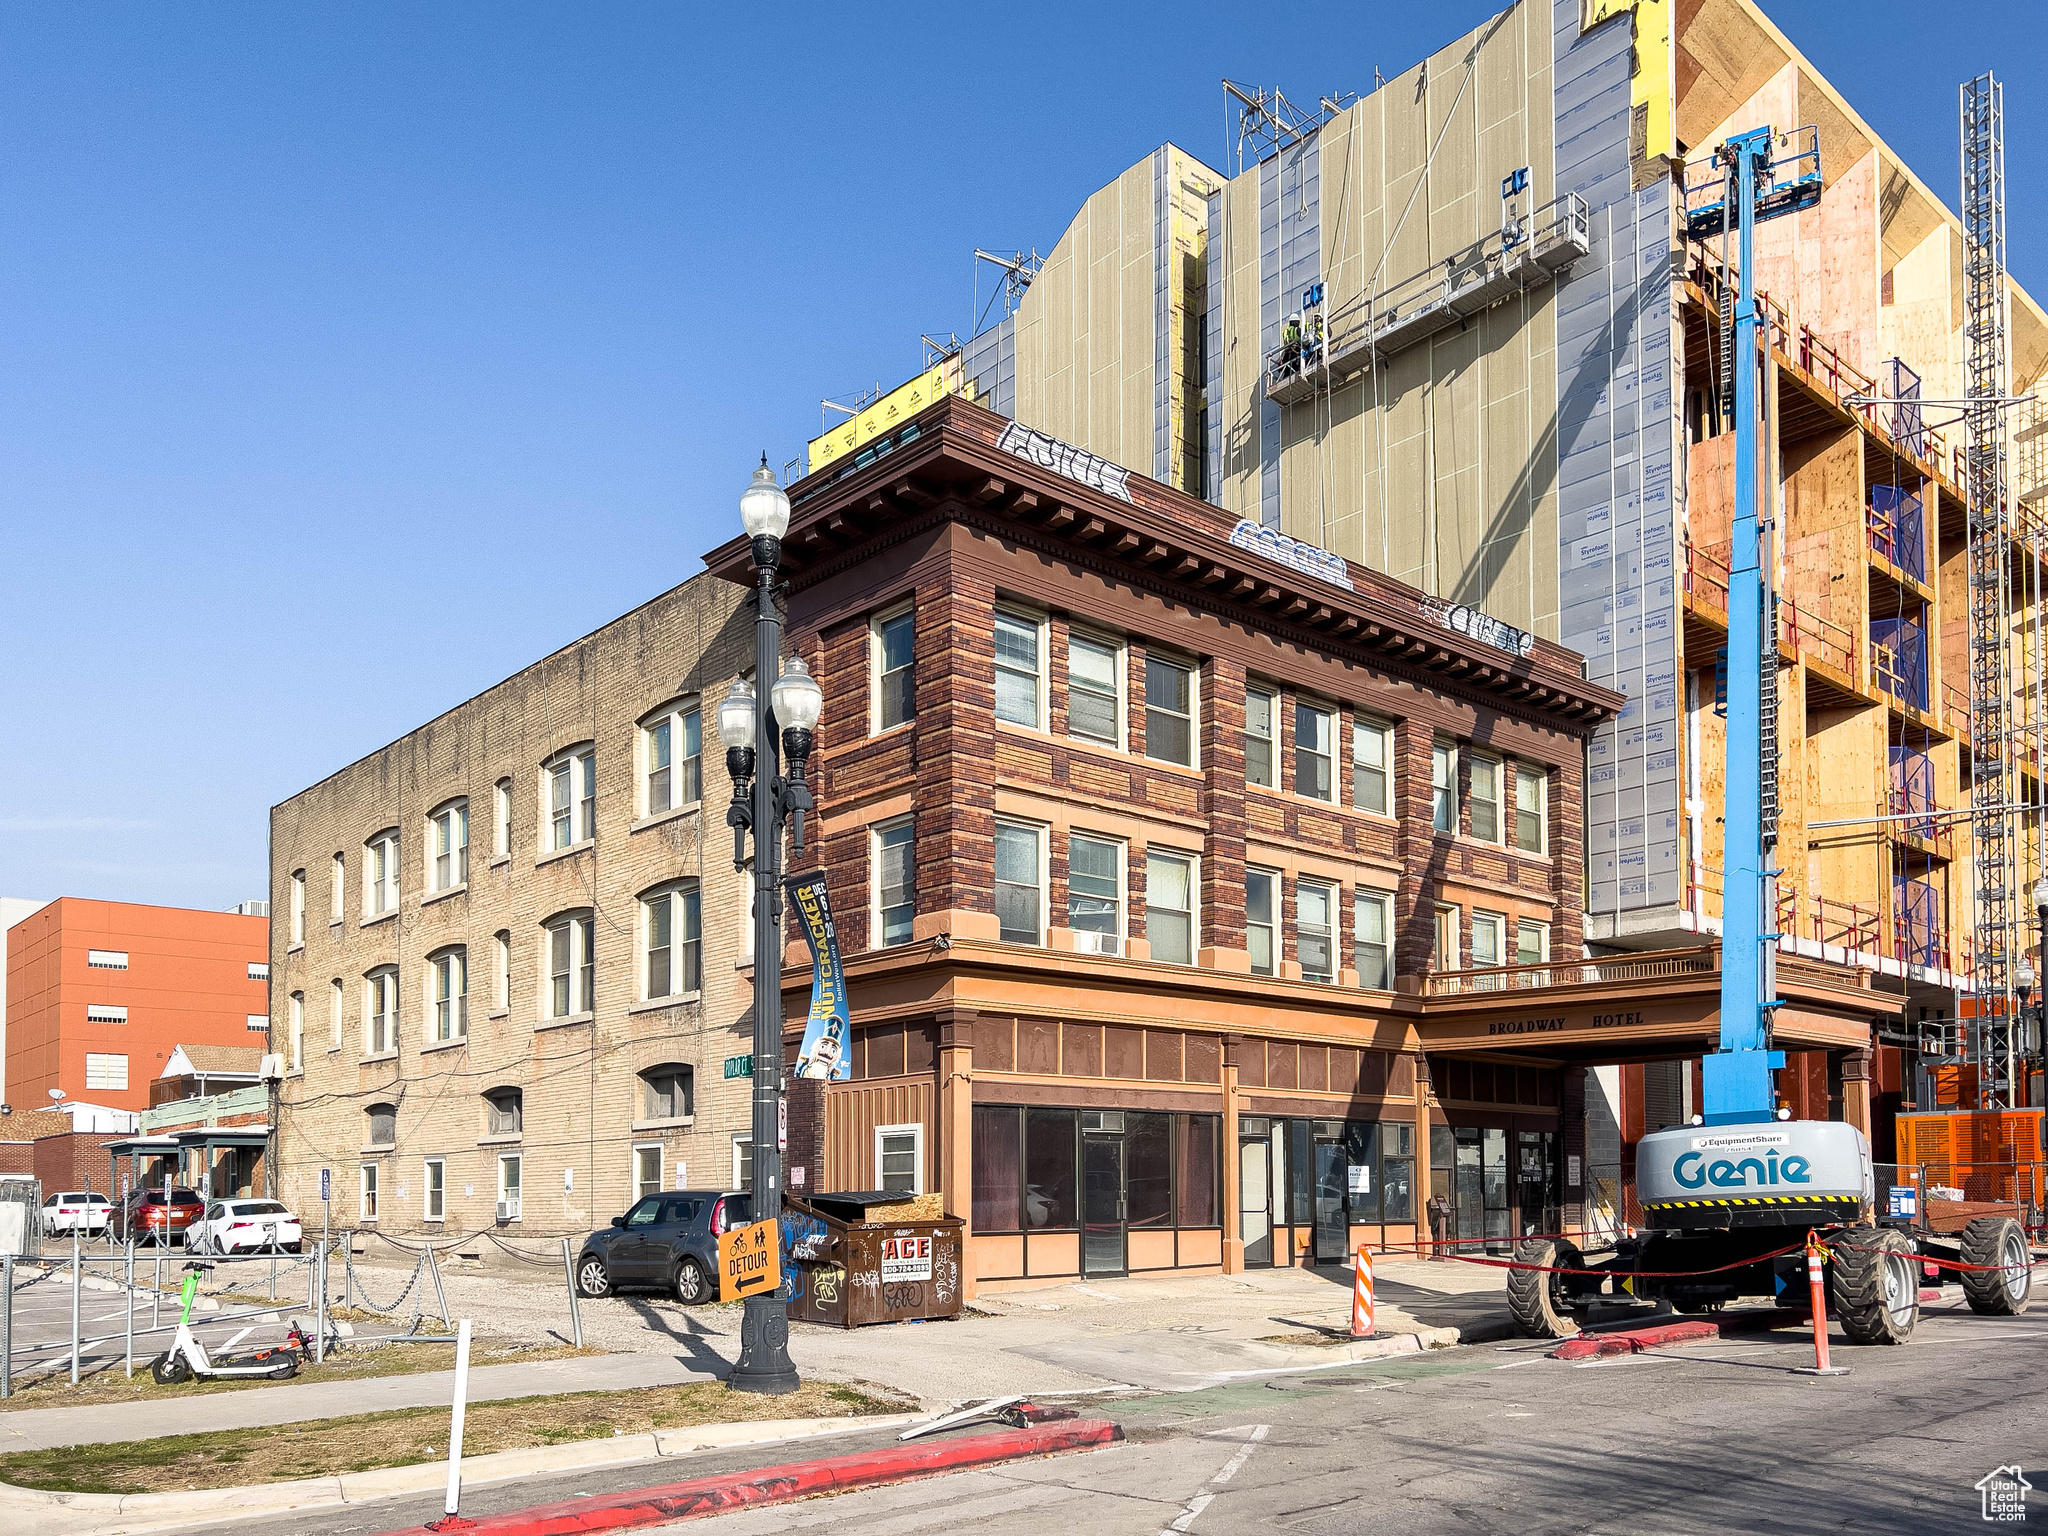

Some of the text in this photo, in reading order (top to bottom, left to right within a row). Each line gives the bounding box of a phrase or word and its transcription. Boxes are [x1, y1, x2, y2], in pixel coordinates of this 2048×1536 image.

[1634, 372, 1663, 387] Styrofom
[1635, 491, 1665, 505] Styrofom
[1580, 543, 1609, 556] Styrofoam
[1637, 618, 1667, 631] Styrofom
[1633, 732, 1663, 744] Styrofam
[812, 882, 827, 896] DEC
[820, 895, 828, 911] 6
[797, 885, 836, 1020] NUTCRACKER
[810, 999, 822, 1021] THE
[1489, 1012, 1643, 1035] BROADWAY HOTEL
[1708, 1135, 1782, 1147] EquipmentShare
[1673, 1148, 1811, 1190] Genie
[883, 1238, 930, 1260] ACE
[729, 1250, 768, 1276] DETOUR
